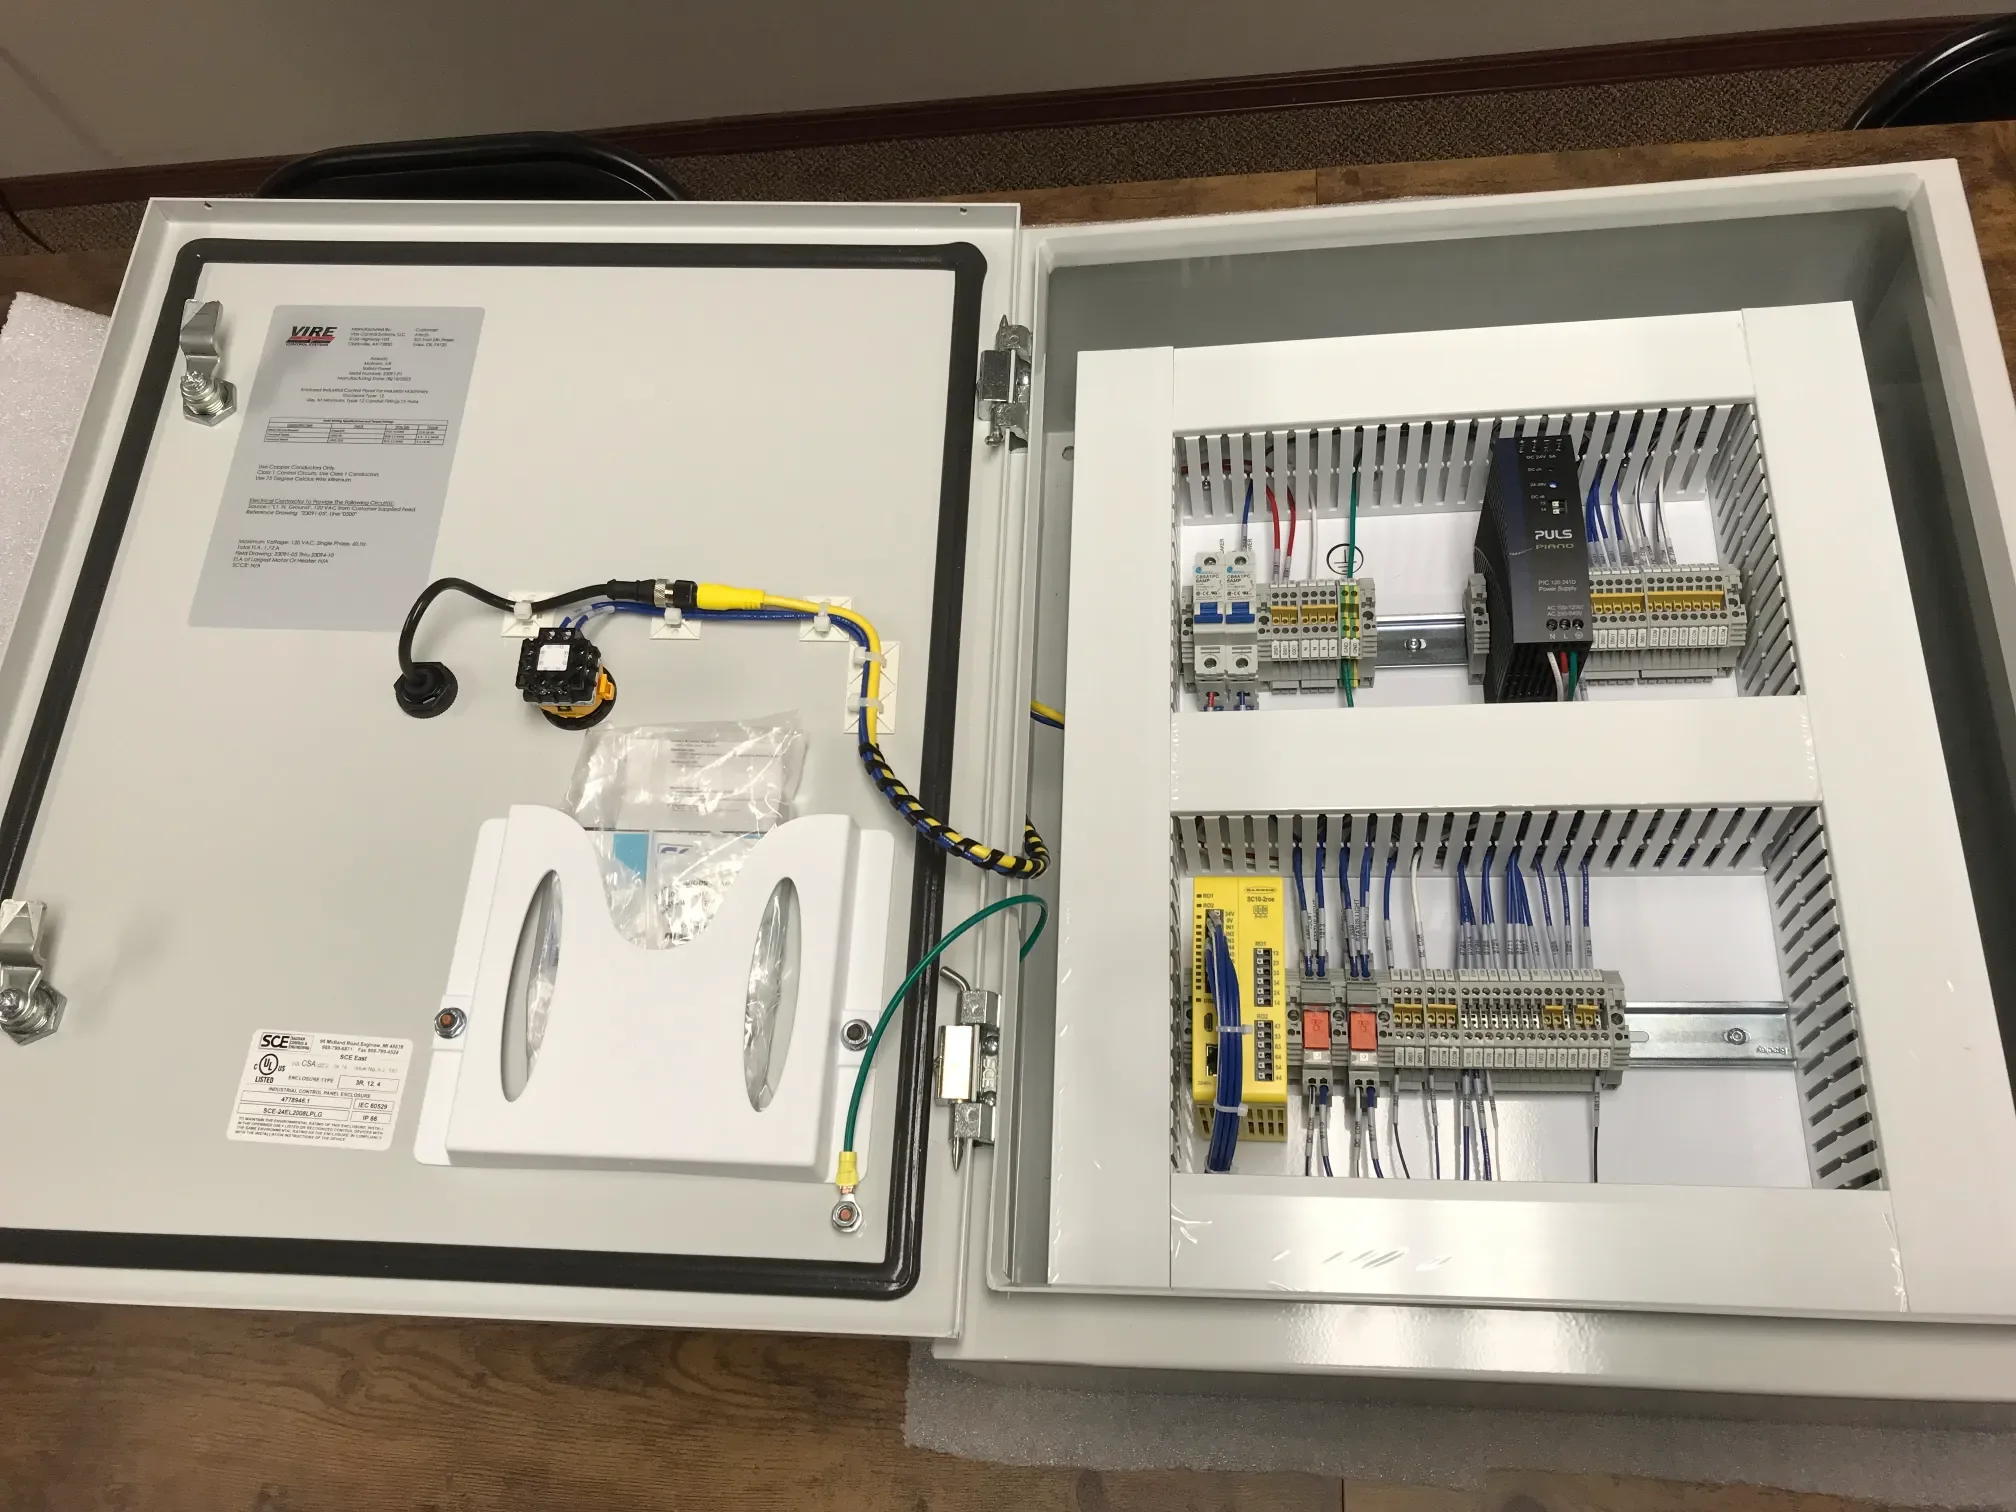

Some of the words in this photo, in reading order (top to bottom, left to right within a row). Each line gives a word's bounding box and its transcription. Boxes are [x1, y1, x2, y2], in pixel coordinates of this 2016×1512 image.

[292, 326, 338, 336] VIRE
[1535, 529, 1573, 540] PULS
[261, 1035, 290, 1048] SCE
[264, 1058, 272, 1071] UL
[1354, 1138, 1360, 1147] DC
